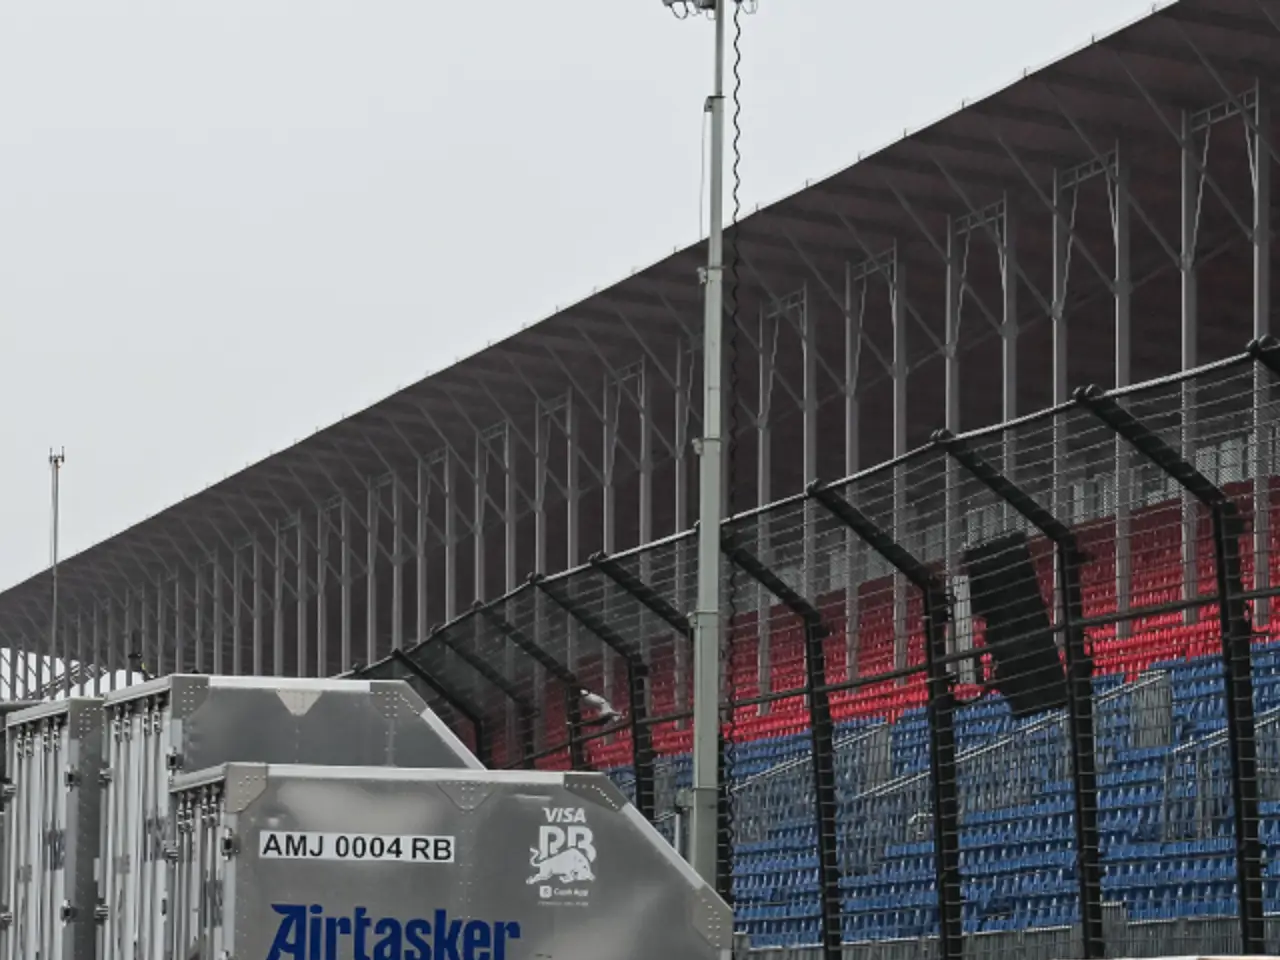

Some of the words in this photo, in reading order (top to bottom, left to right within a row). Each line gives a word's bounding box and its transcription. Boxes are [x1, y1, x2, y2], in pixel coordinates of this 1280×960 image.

[543, 807, 587, 823] VISA
[262, 834, 324, 857] AMJ
[335, 836, 402, 858] 0004
[412, 838, 452, 861] RB
